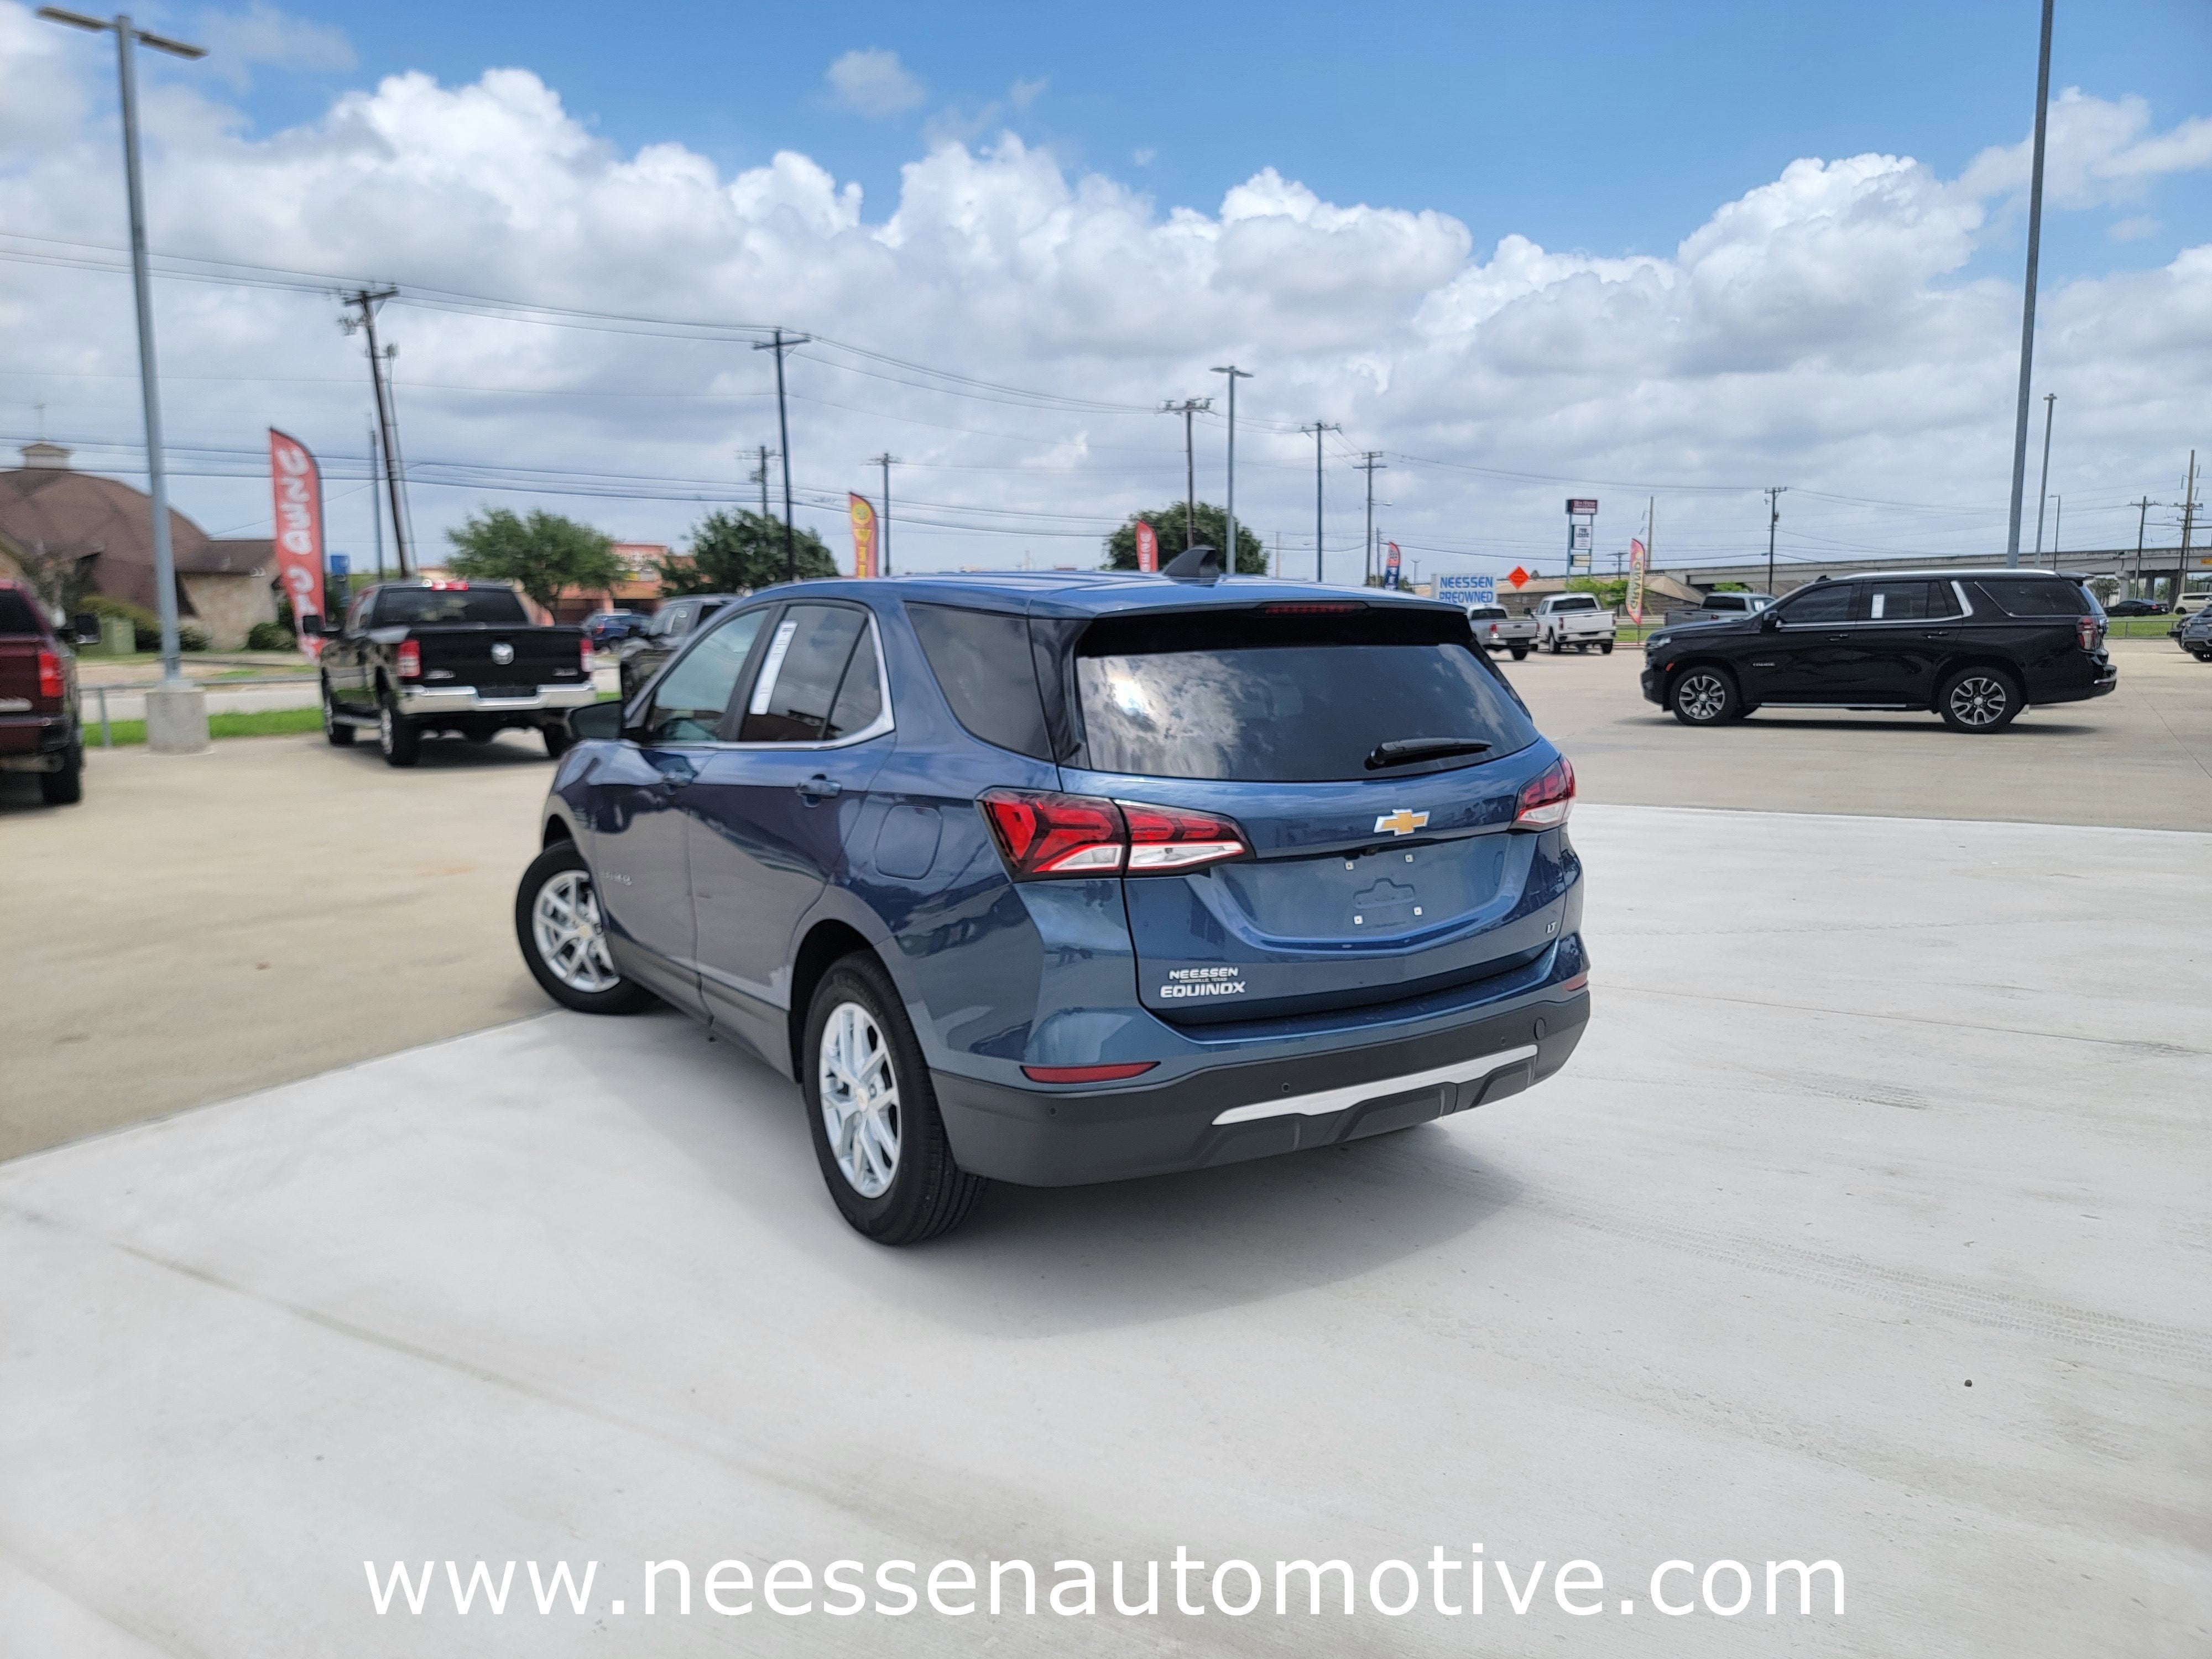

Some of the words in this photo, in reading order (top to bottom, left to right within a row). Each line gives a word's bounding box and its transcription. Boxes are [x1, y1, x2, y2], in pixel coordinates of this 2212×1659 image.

[1439, 576, 1494, 589] NEESSEN
[1439, 591, 1494, 604] PREOWNED
[1546, 921, 1557, 934] LT
[1168, 967, 1239, 980] NEESSEN
[1160, 980, 1246, 999] EQUINOX
